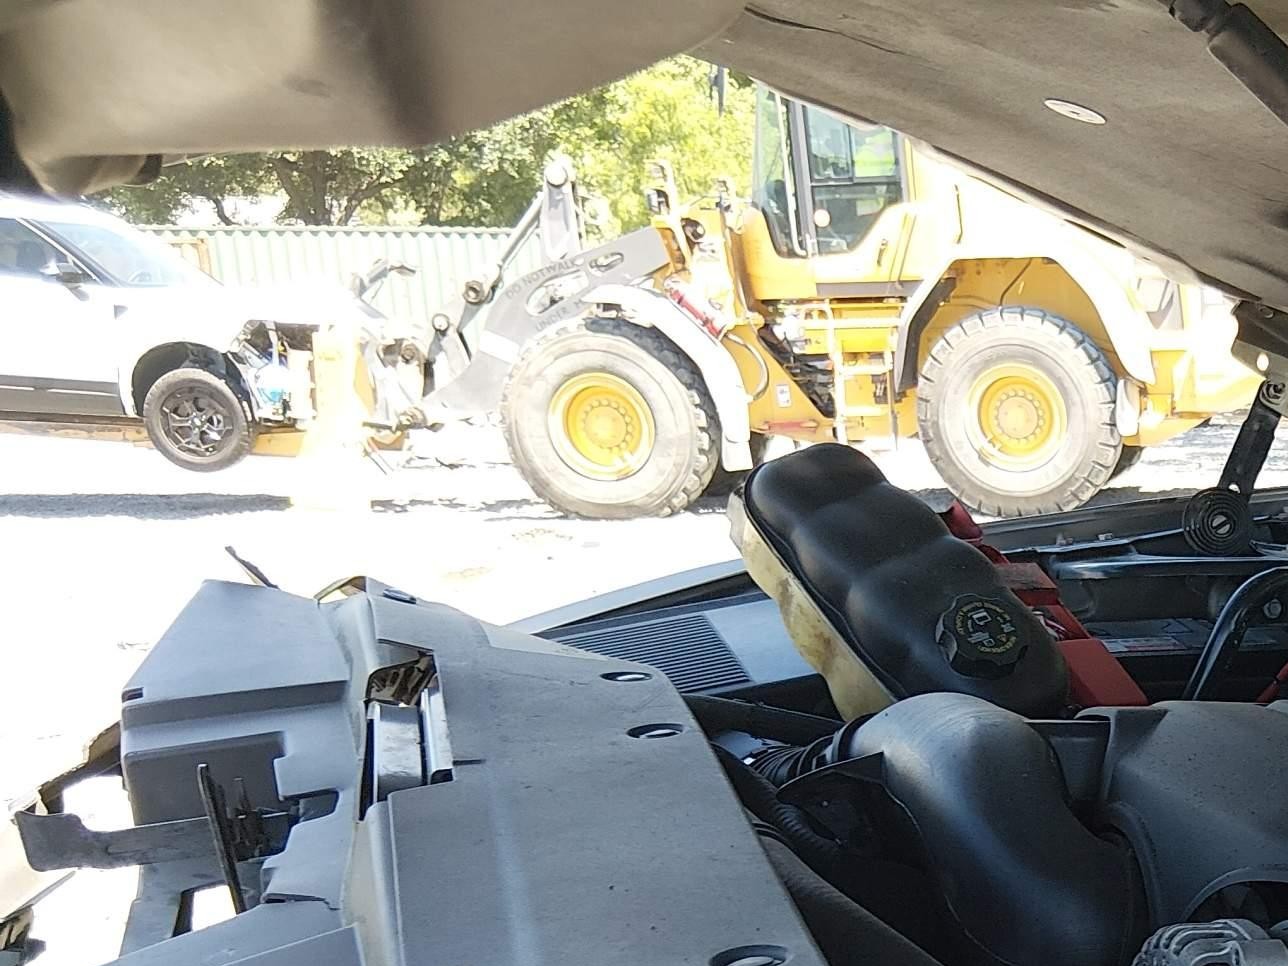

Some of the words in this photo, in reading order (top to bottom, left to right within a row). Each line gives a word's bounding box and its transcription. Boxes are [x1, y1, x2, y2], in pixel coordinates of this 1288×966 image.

[505, 283, 521, 300] DO
[522, 268, 547, 287] NOT
[546, 258, 578, 275] WALK
[535, 307, 568, 332] UNDER
